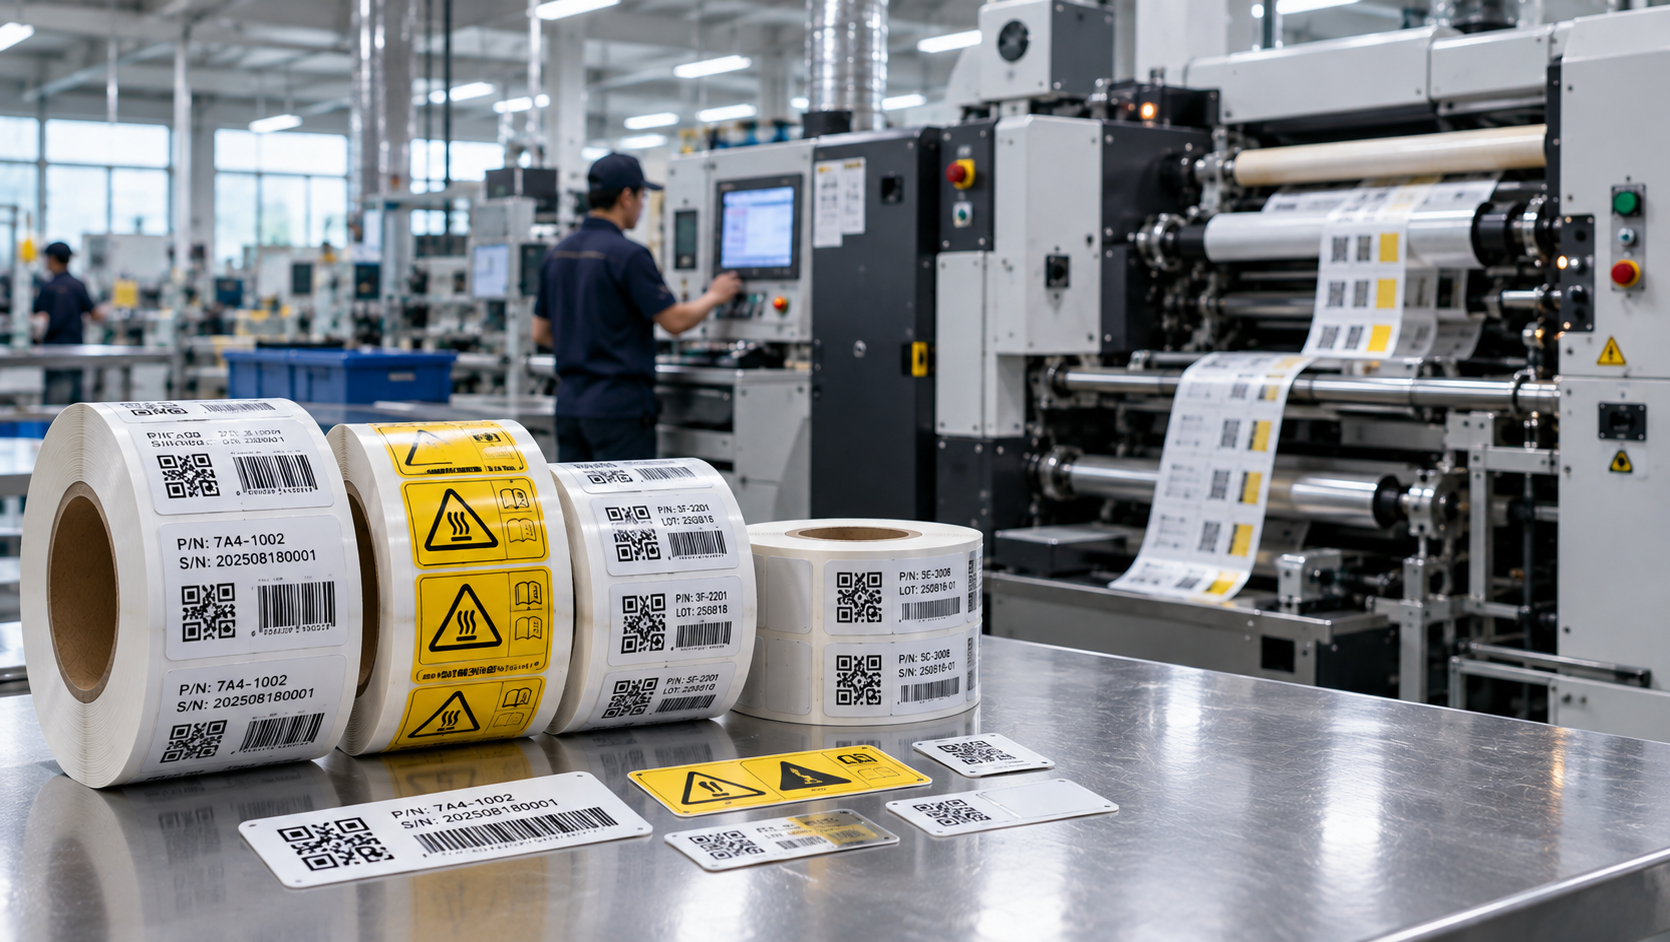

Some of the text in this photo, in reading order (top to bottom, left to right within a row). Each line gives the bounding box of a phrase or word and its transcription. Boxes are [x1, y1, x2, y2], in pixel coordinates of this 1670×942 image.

[661, 516, 680, 527] LOT:
[177, 533, 285, 550] P/N: 7A4-1002
[179, 549, 316, 569] S/N: 202508180001
[899, 571, 919, 581] P/N:
[899, 585, 918, 596] LOT:
[695, 591, 727, 602] 3F-2201
[676, 607, 695, 618] LOT:
[898, 654, 918, 664] P/N:
[898, 667, 917, 678] S/N:
[179, 674, 288, 696] P/N: 7A4-1002
[176, 688, 314, 713] S/N: 202508180001
[390, 793, 516, 819] P/N: 7A4-1002
[400, 798, 559, 829] S/N: 202508180001
